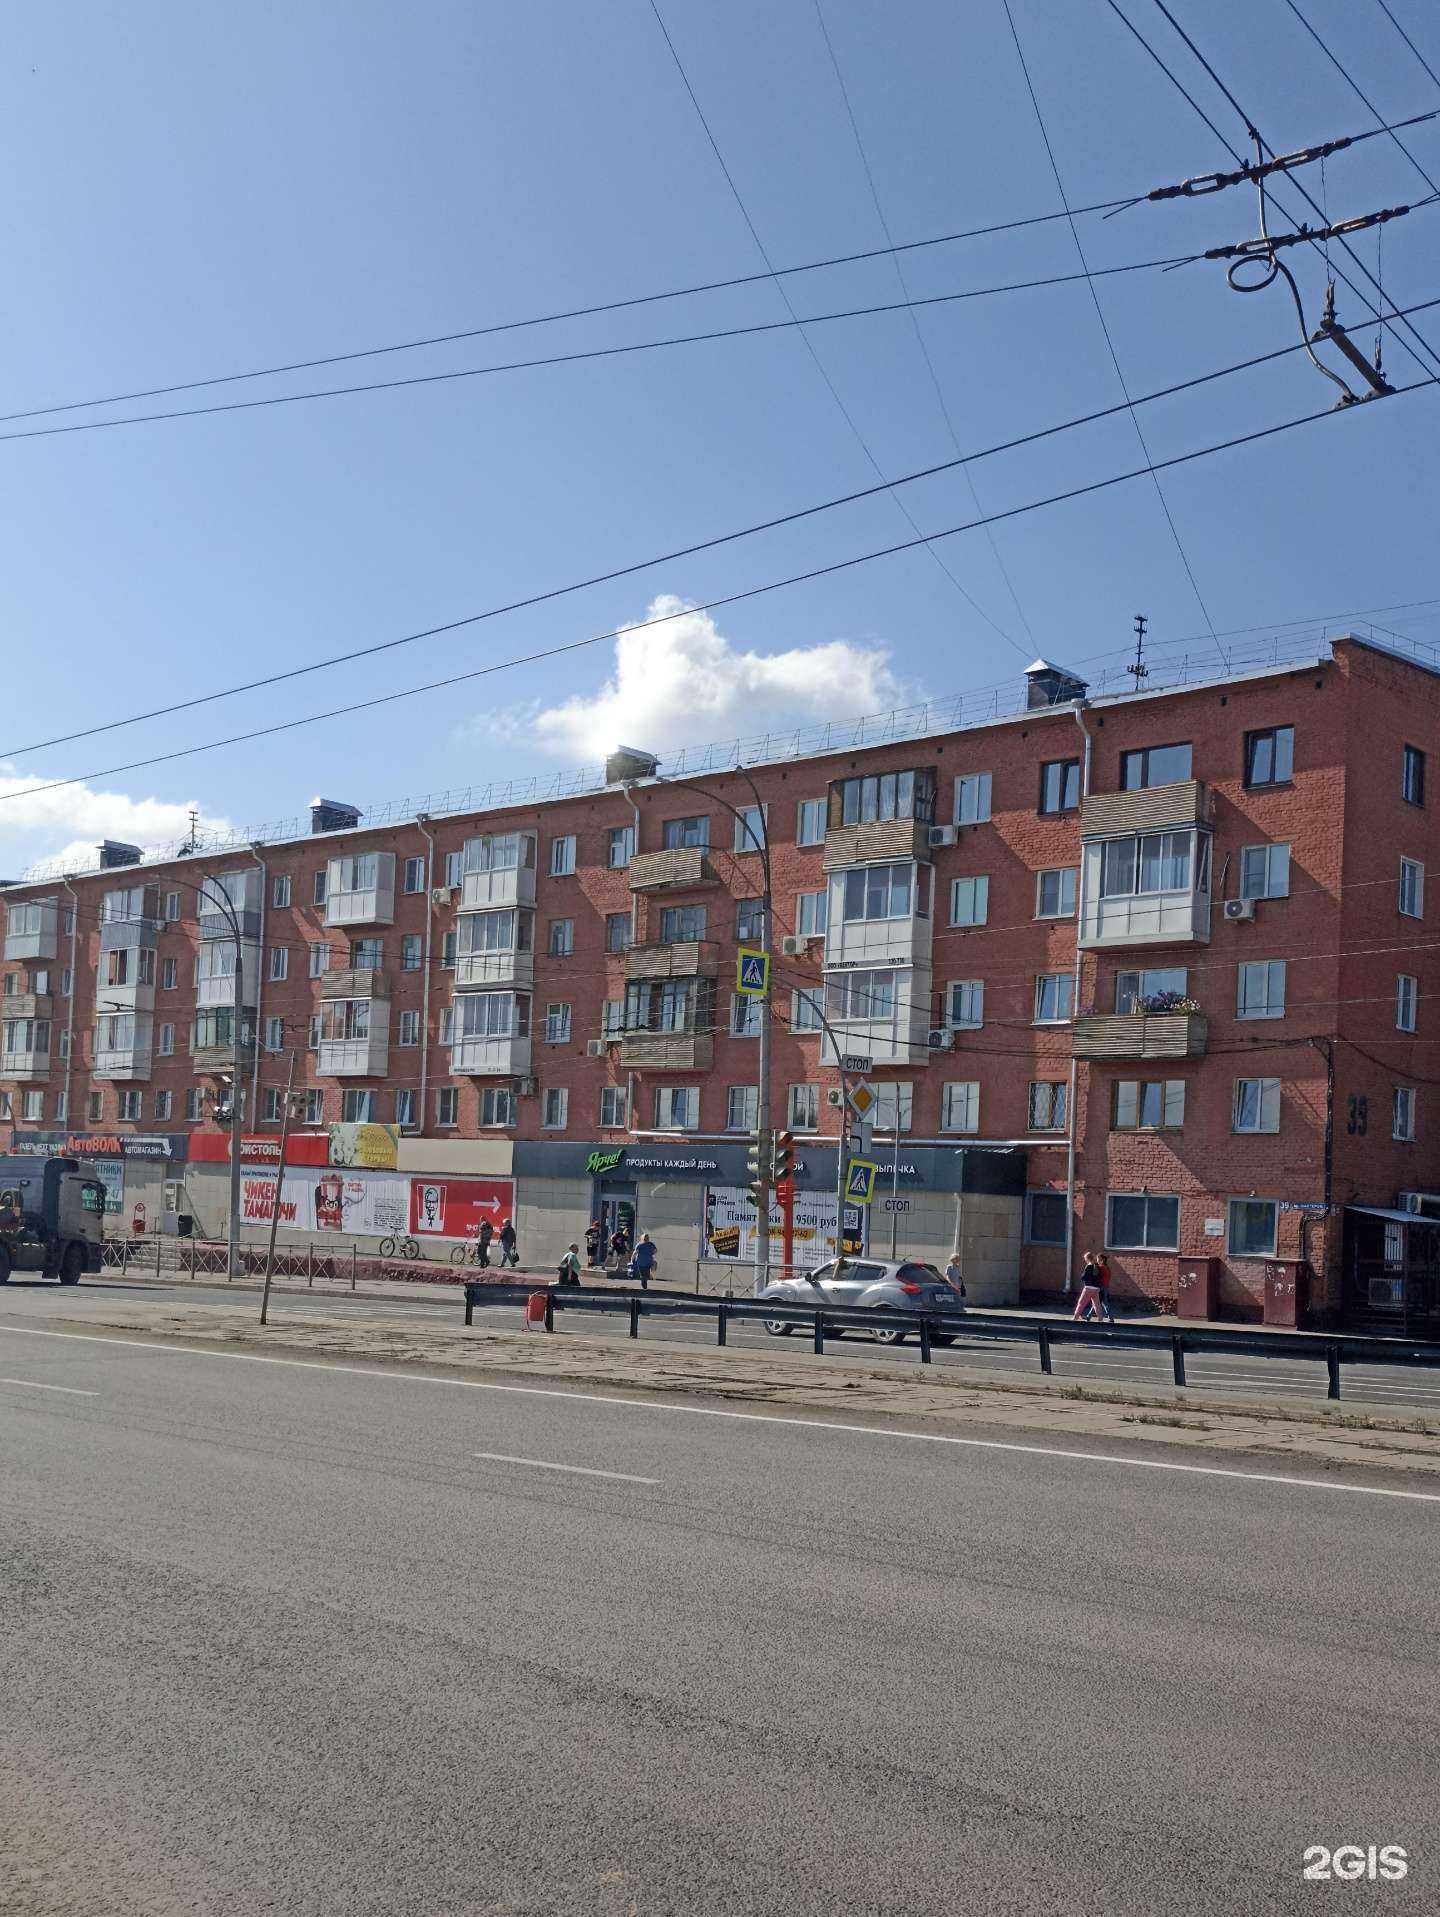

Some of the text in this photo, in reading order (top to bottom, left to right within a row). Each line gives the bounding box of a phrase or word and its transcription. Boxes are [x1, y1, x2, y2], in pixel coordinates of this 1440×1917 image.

[846, 1057, 869, 1071] СТОП
[124, 1146, 162, 1155] АВТОМАГАЗИН
[586, 1149, 624, 1172] Ярче!
[626, 1158, 717, 1169] ПРОДУКТЫ КАЖДЫЙ ДЕНЬ
[874, 1164, 916, 1174] ВЫПЧКА
[885, 1200, 910, 1212] СТОП
[1280, 1201, 1290, 1209] 39
[727, 1210, 781, 1223] Памятки
[796, 1214, 838, 1230] 9500 руб
